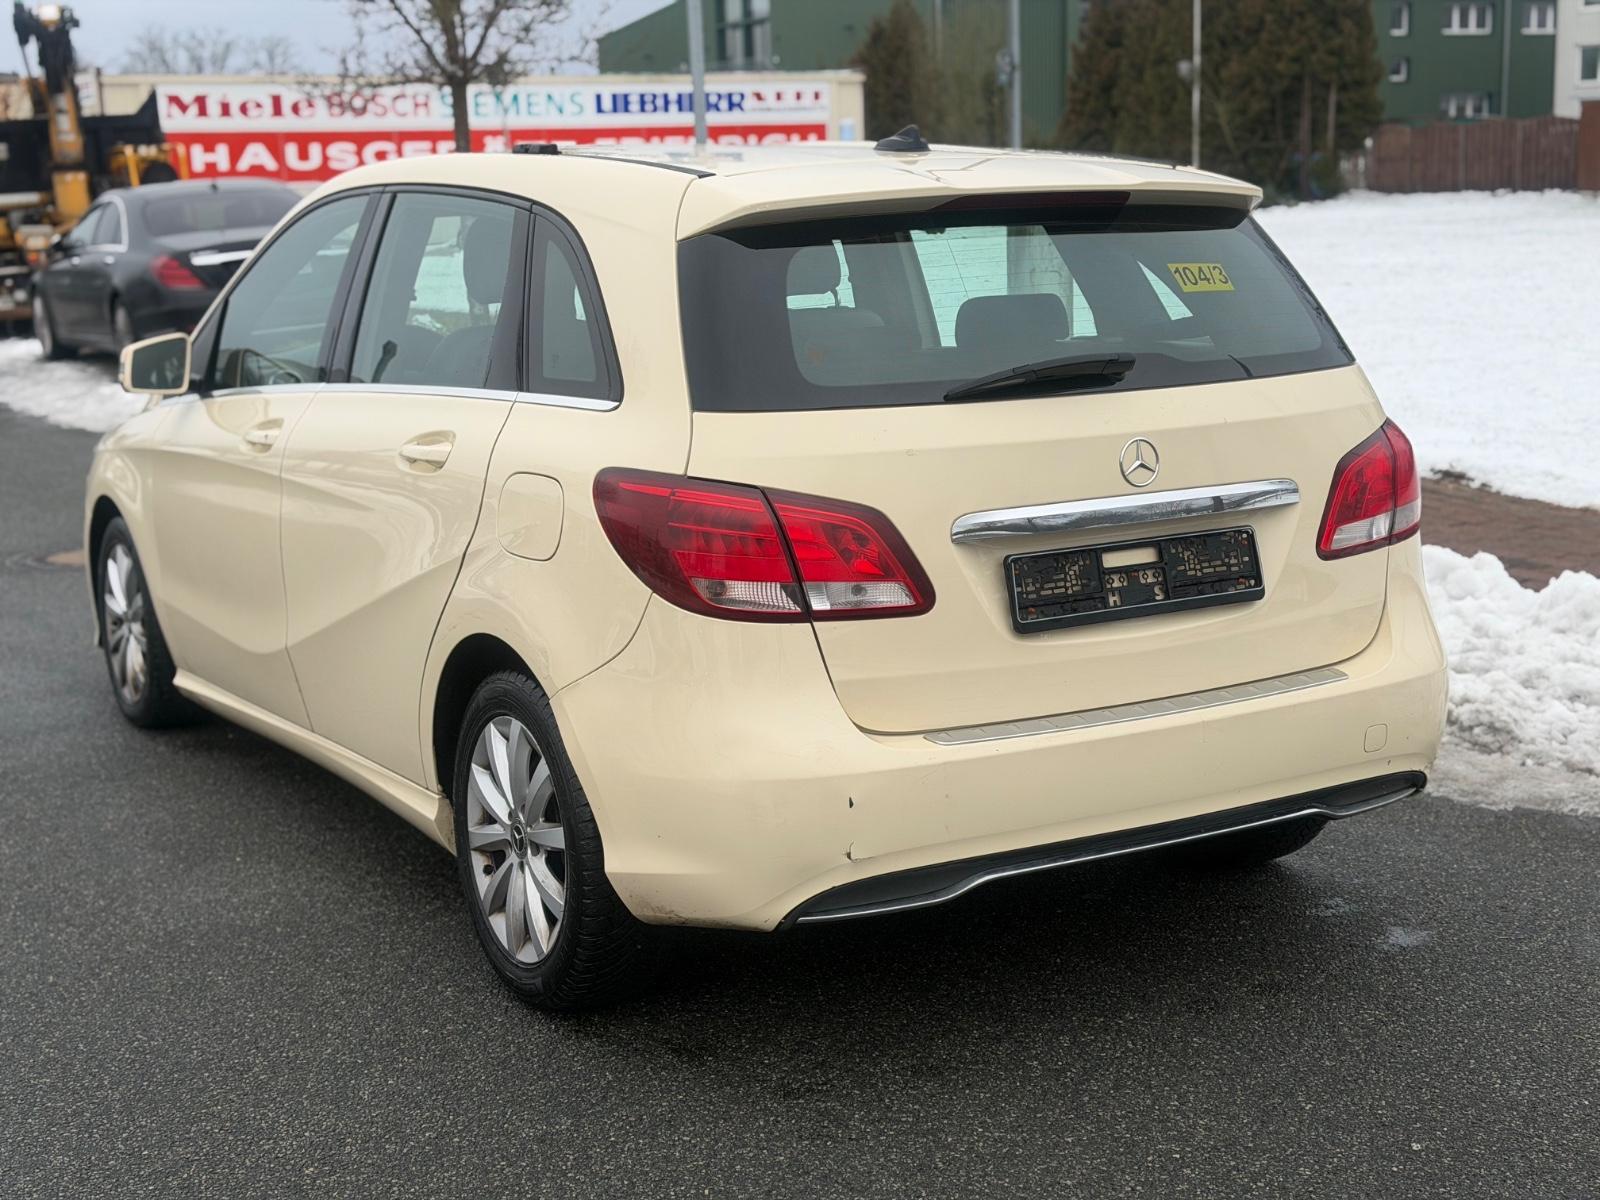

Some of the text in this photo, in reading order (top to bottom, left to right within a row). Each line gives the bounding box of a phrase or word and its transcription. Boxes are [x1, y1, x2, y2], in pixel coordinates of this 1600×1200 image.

[166, 94, 315, 118] Miele
[327, 91, 431, 118] BOSCH
[440, 91, 584, 117] SEMENS
[1173, 265, 1229, 287] 104/3
